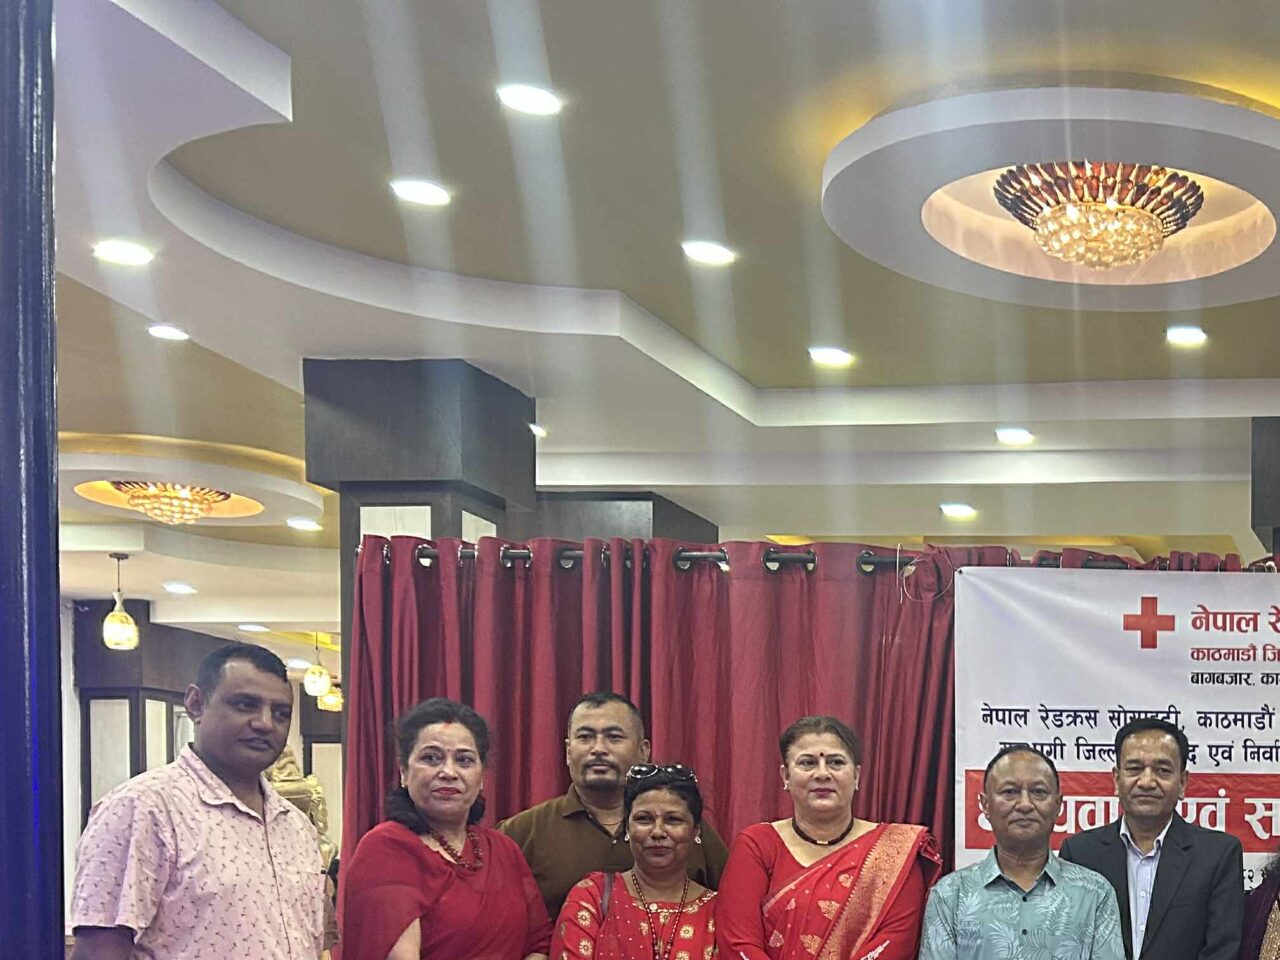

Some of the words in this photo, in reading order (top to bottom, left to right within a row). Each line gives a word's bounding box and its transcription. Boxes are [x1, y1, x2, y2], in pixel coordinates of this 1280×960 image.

[1190, 605, 1260, 634] नेपाल
[981, 703, 1030, 728] नेपाल
[1038, 704, 1099, 730] रेडक्रस
[1196, 703, 1276, 731] काठमाडौं
[1207, 740, 1235, 767] एवं
